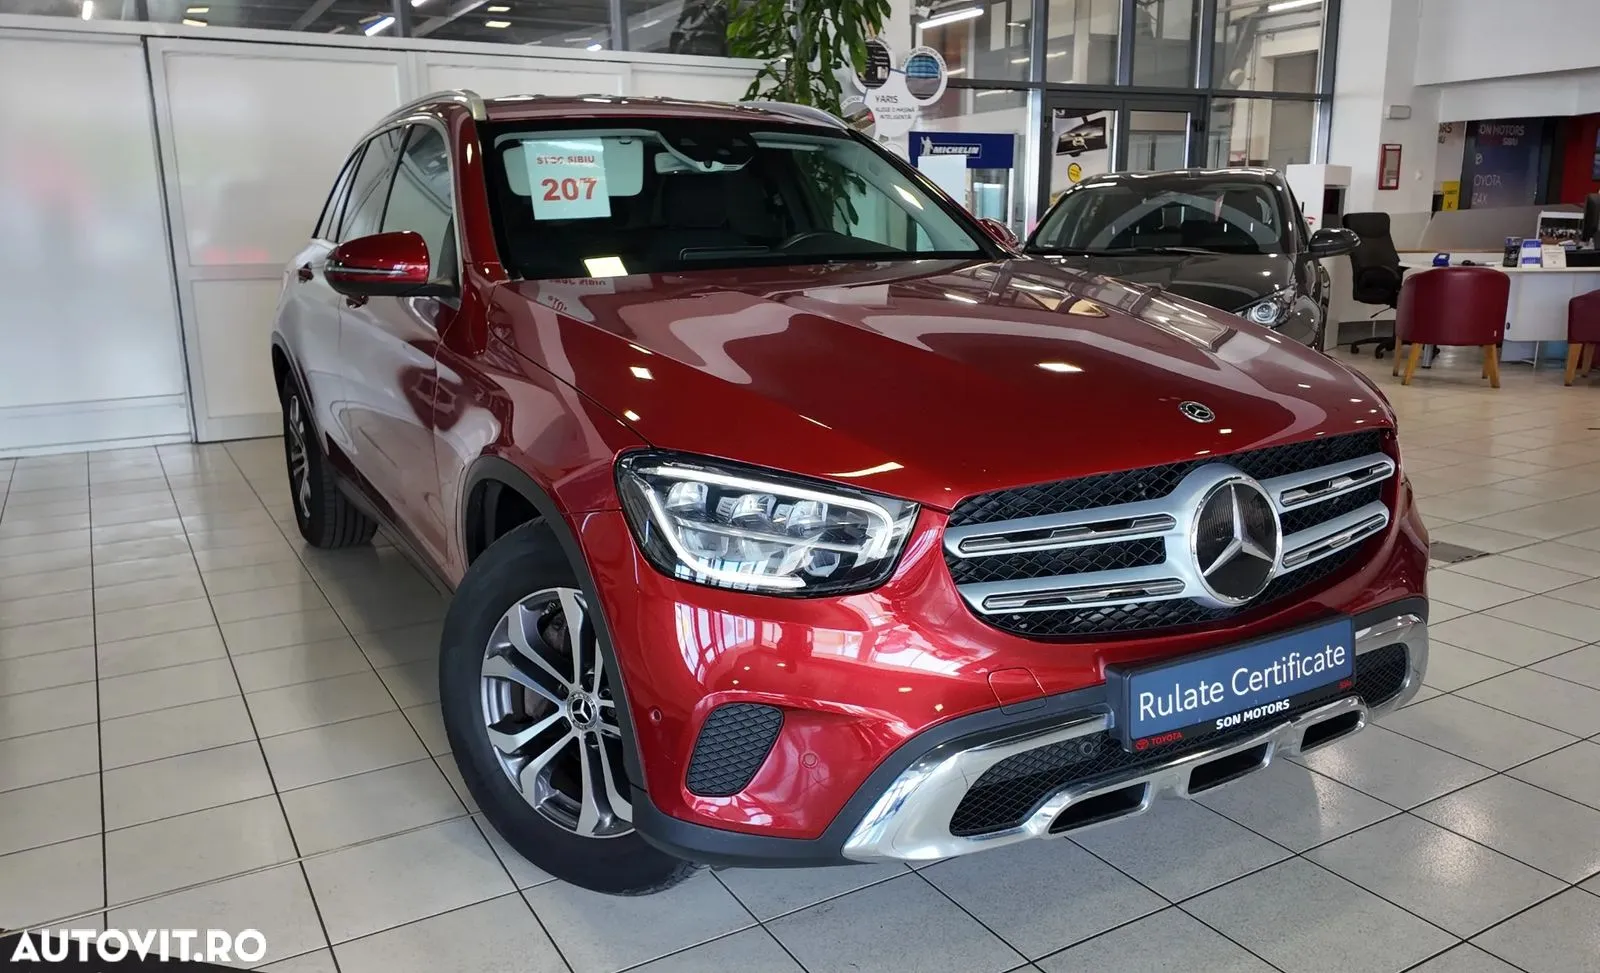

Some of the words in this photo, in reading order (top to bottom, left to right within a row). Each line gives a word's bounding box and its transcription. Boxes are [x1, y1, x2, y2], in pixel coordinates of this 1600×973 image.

[875, 95, 899, 103] YARIS
[1493, 125, 1525, 136] MOTORS
[933, 146, 979, 154] MICHELIN
[567, 155, 595, 164] SIBIU
[1473, 174, 1502, 186] OYOTA
[541, 177, 598, 201] 207
[1138, 680, 1225, 722] Rulate
[1231, 644, 1346, 696] Certificate
[1216, 713, 1241, 730] SON
[1243, 698, 1290, 722] MOTORS
[1151, 731, 1183, 745] TOYOTA
